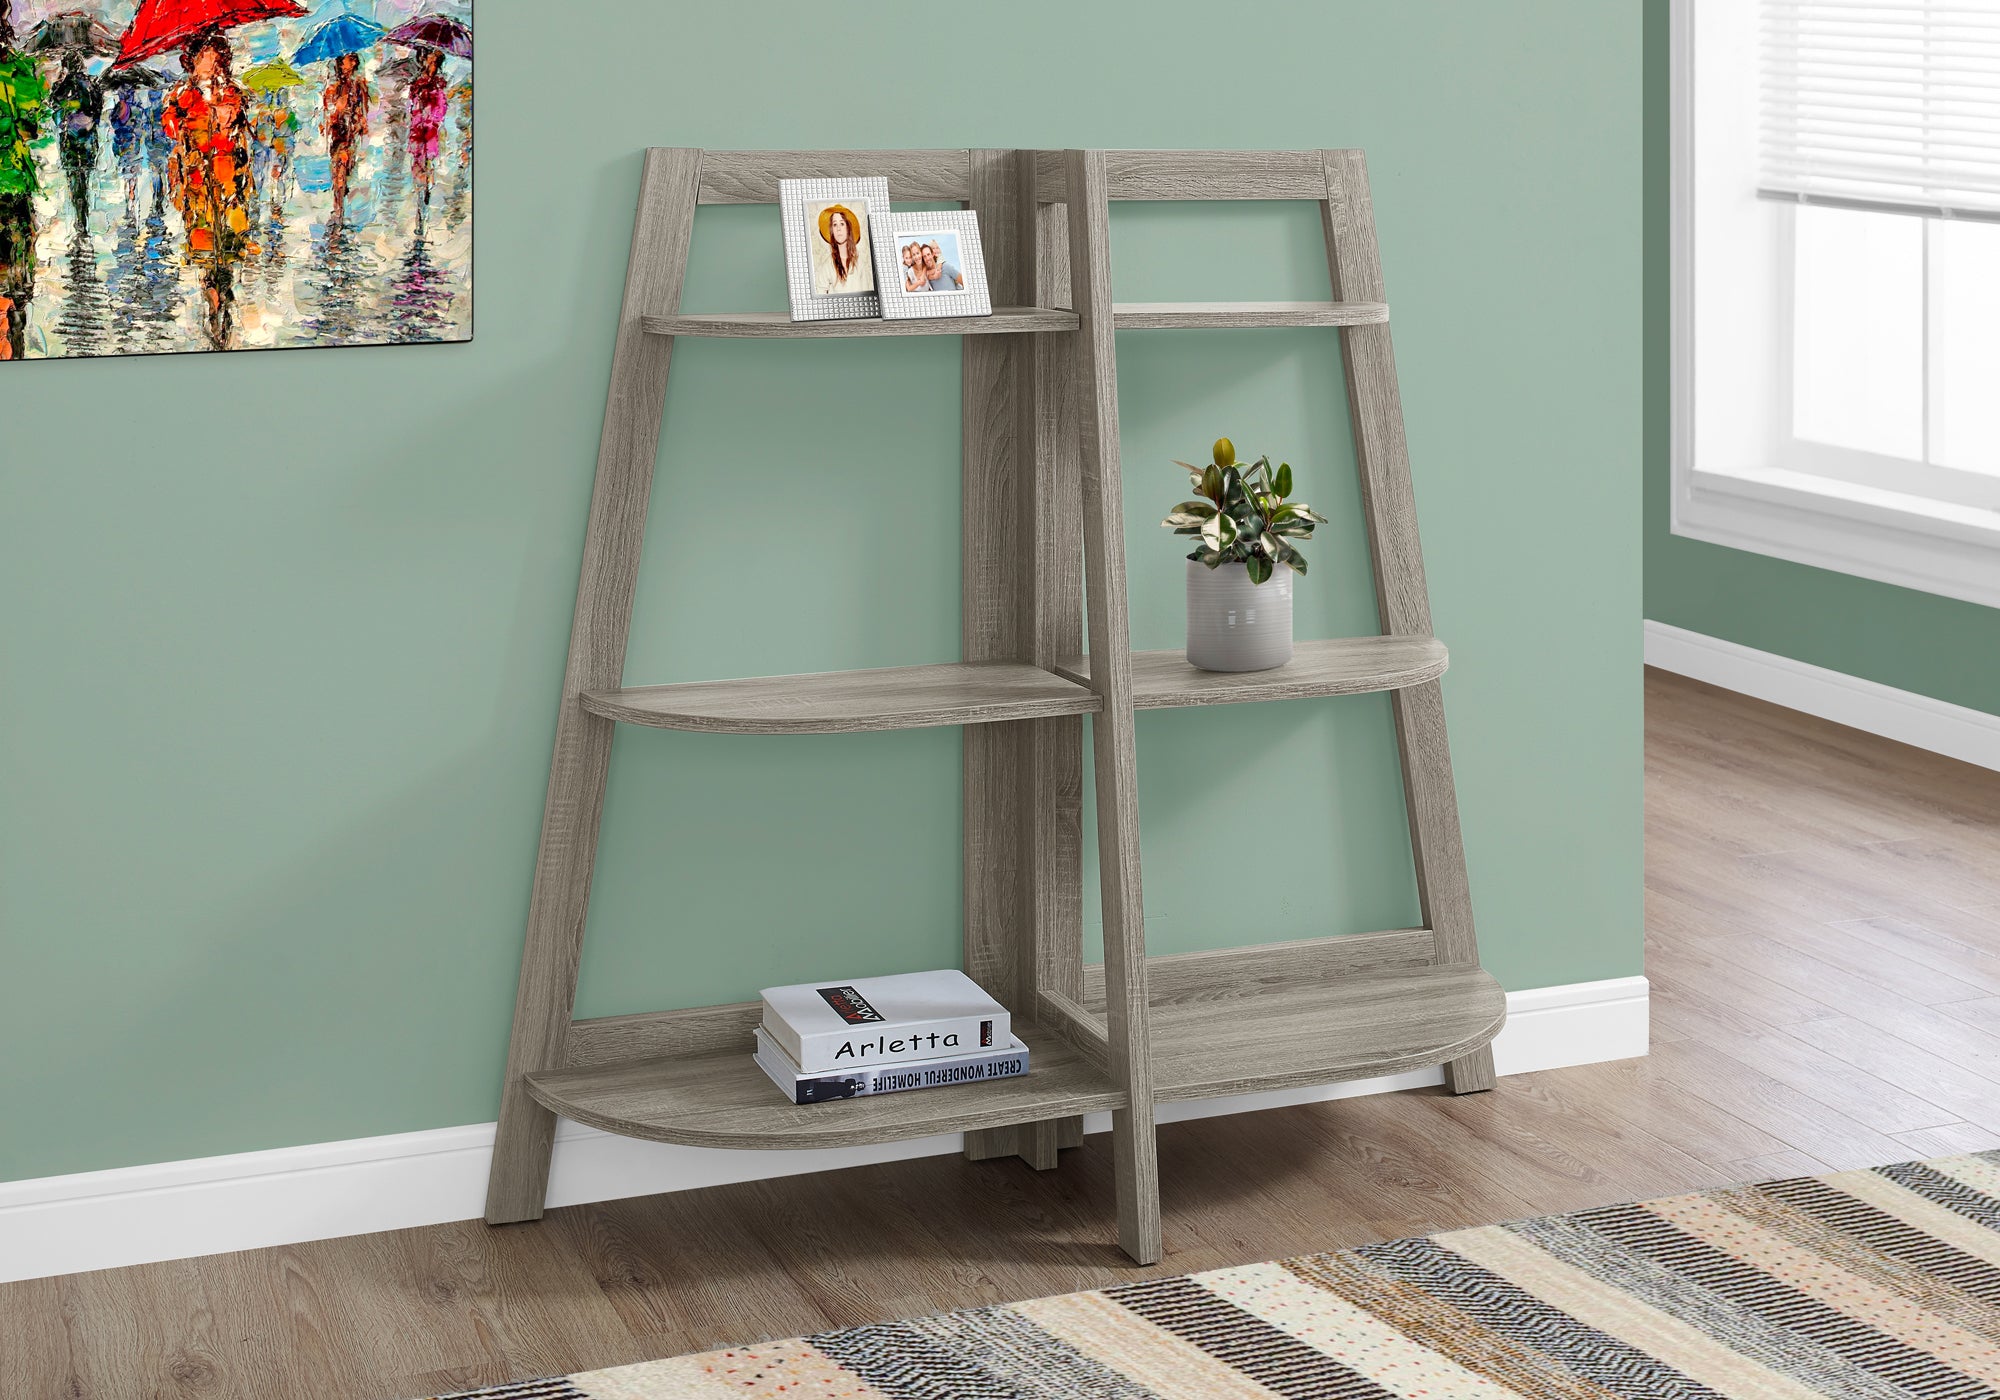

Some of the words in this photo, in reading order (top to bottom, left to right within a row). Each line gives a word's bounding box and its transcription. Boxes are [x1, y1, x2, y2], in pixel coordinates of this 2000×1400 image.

[834, 1032, 959, 1060] Arletta
[924, 1061, 985, 1085] WONDERFUL
[987, 1059, 1022, 1076] CREATE
[872, 1072, 921, 1092] HOMELIFE
